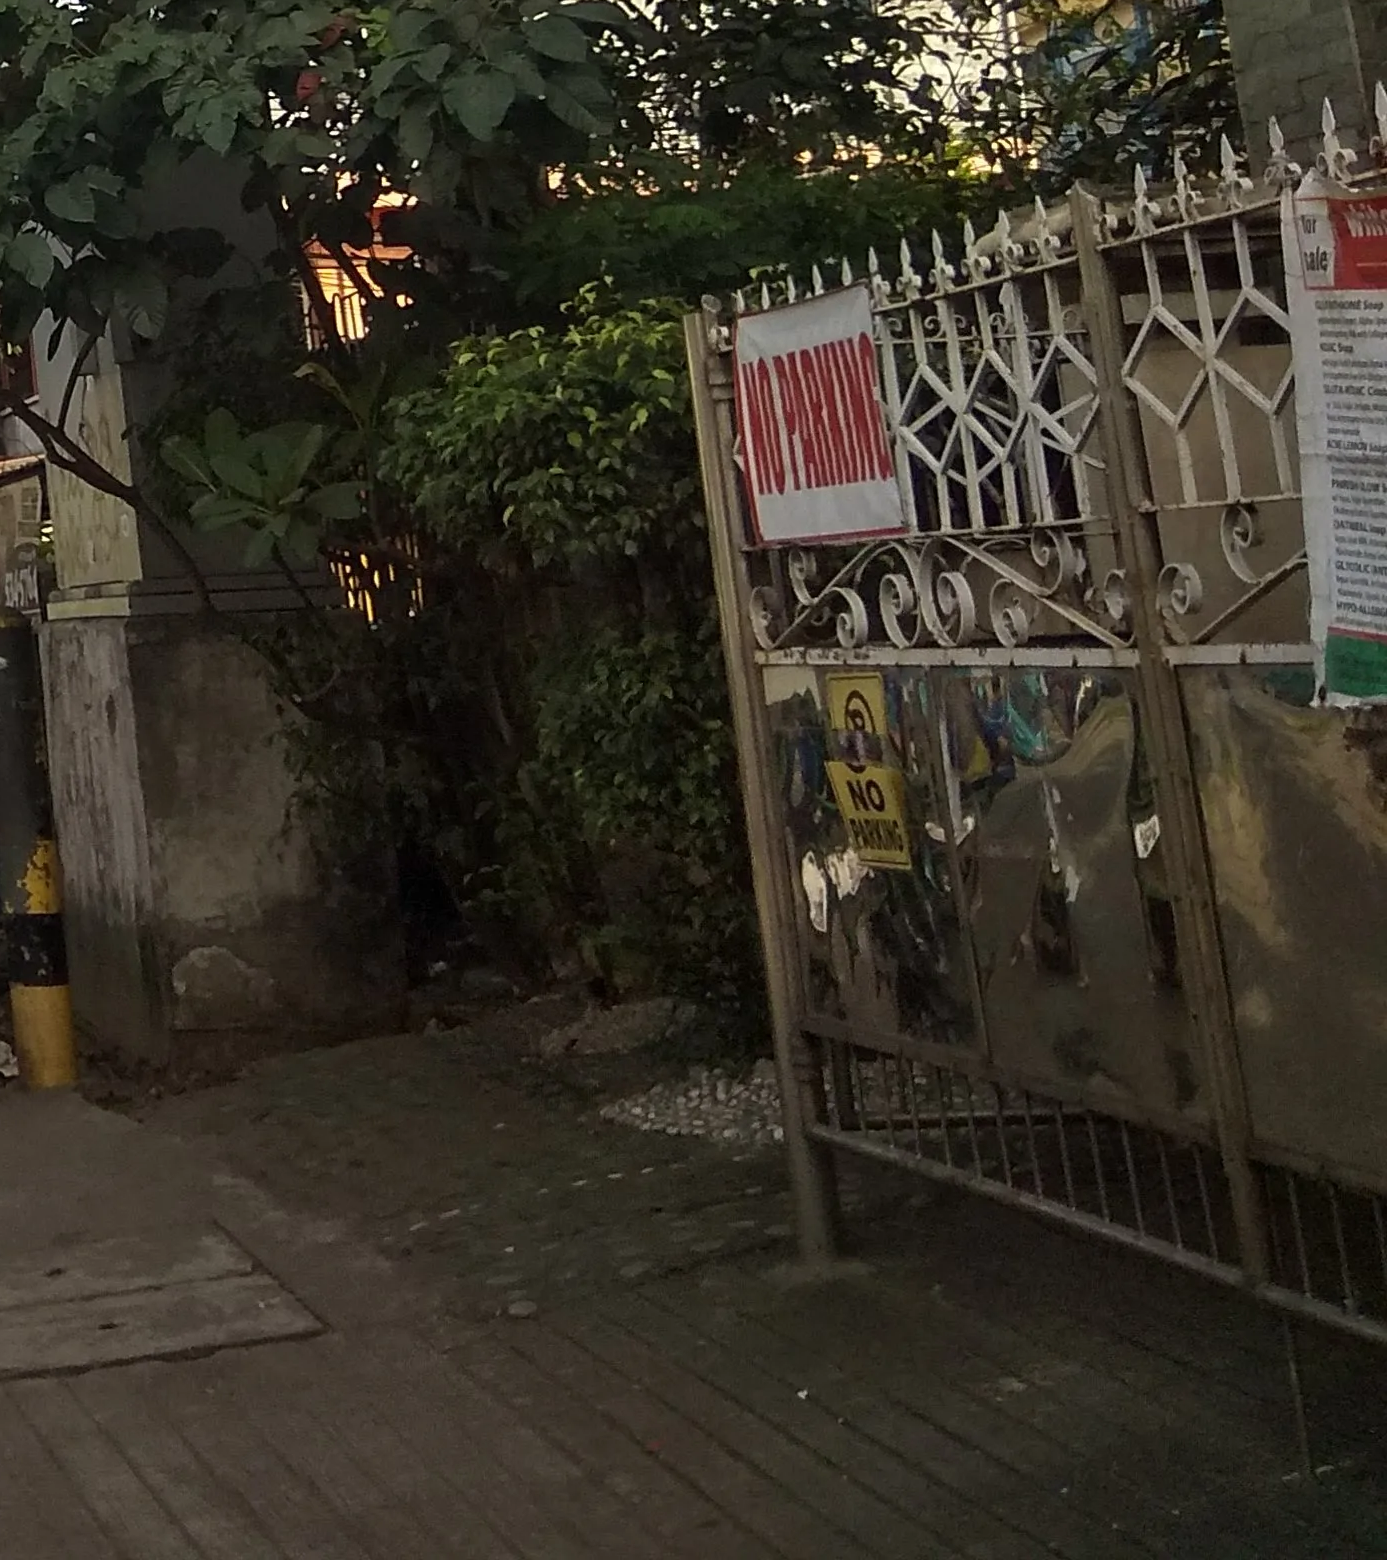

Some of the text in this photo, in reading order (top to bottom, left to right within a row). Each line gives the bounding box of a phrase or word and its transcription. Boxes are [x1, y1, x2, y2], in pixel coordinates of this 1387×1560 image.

[741, 331, 895, 496] NO PARKING
[846, 778, 886, 813] NO
[849, 818, 904, 853] PARKING
